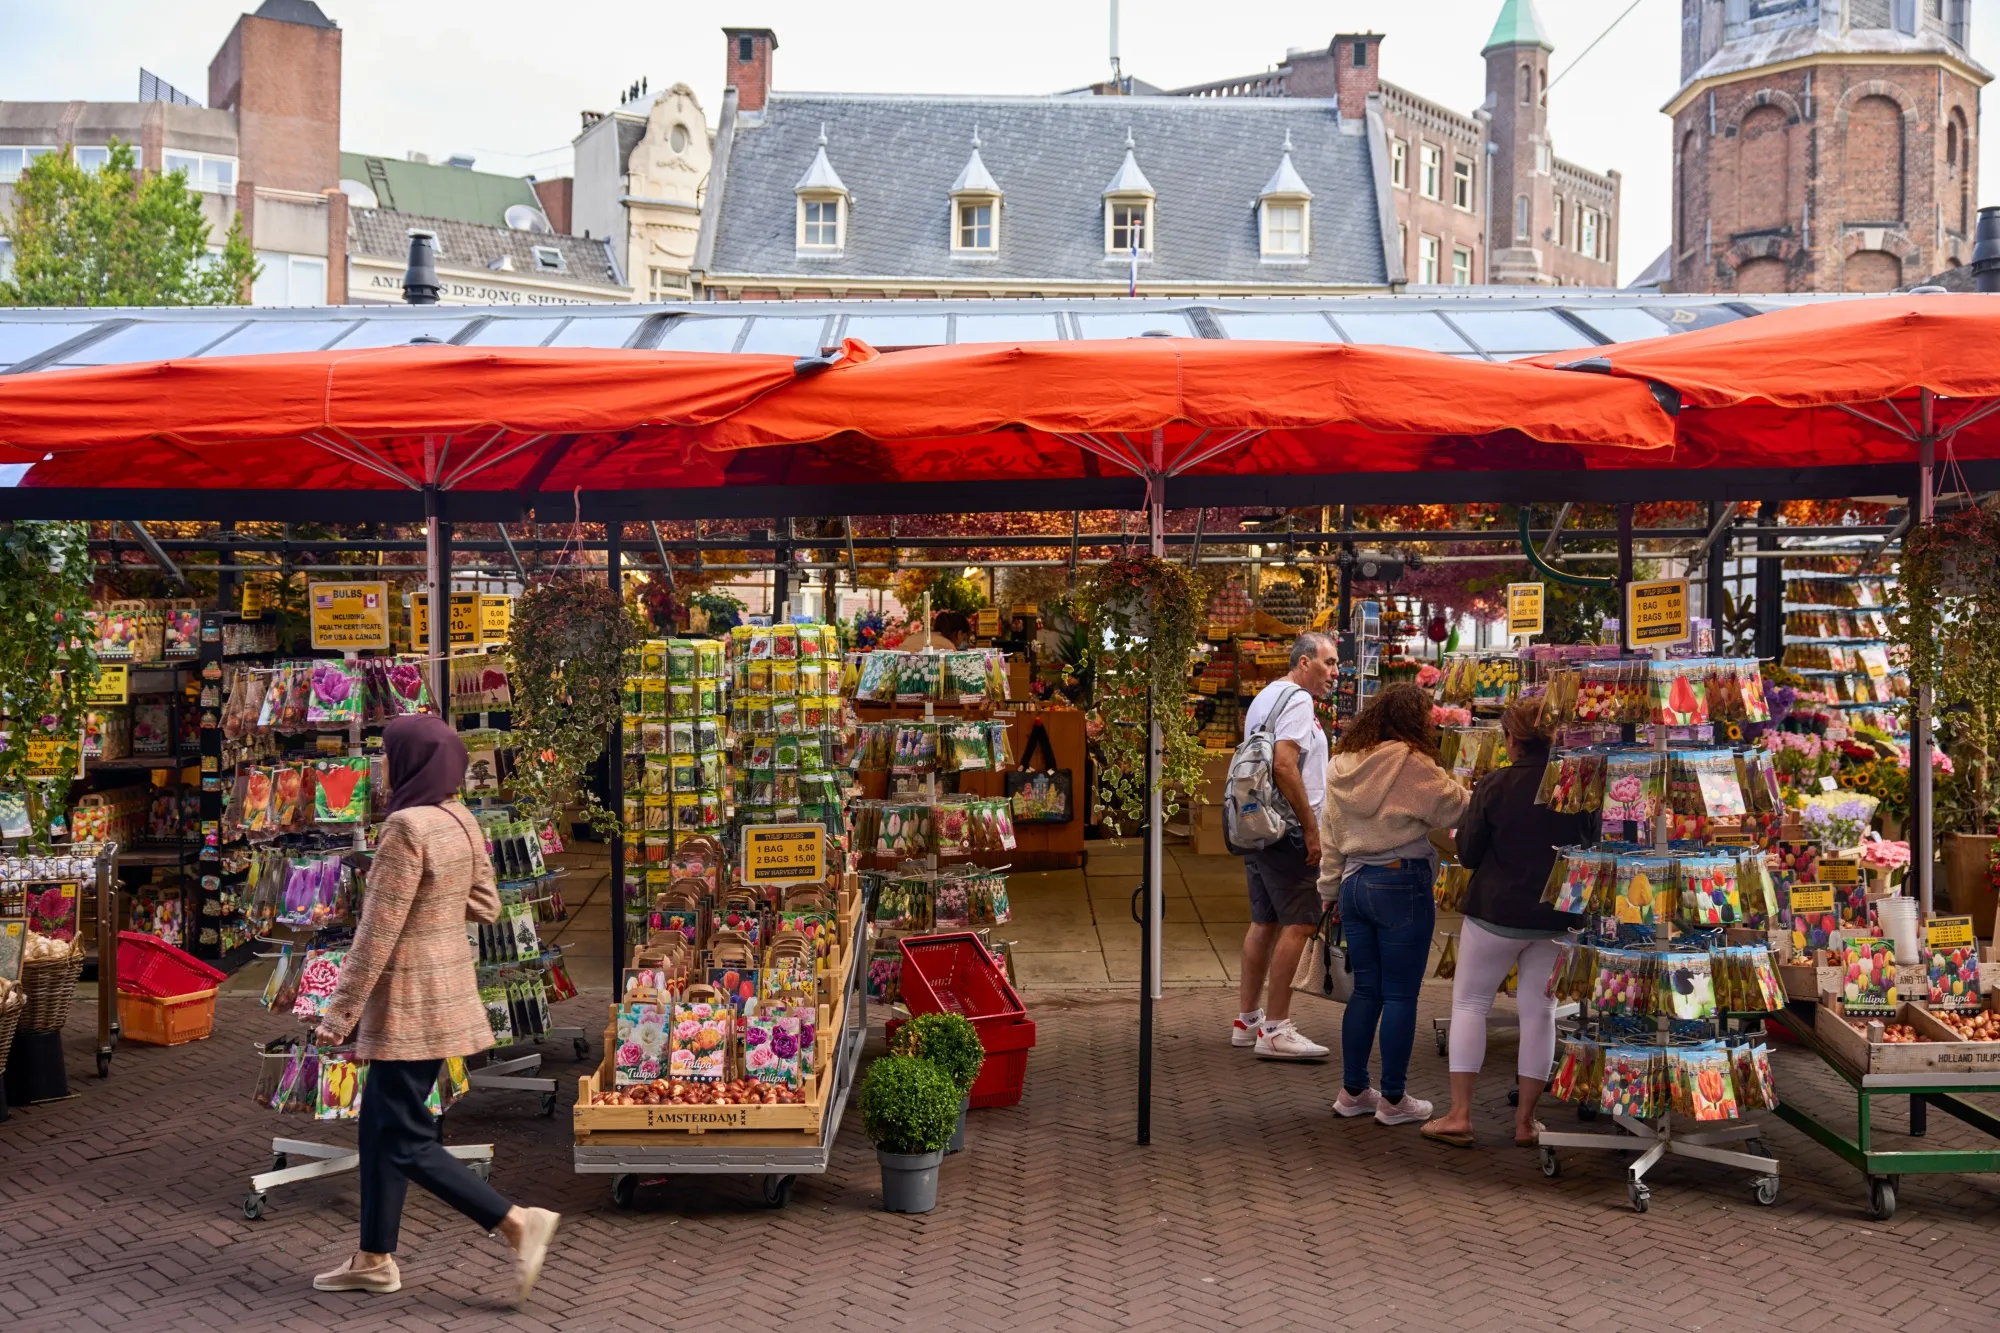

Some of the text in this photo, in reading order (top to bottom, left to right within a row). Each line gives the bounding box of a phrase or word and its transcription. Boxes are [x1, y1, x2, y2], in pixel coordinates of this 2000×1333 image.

[453, 285, 475, 298] DE
[333, 590, 362, 598] BULBS
[1642, 601, 1658, 610] BAG
[1667, 599, 1680, 608] 6,00
[1637, 611, 1681, 623] 2 BAGS 10,00
[420, 622, 427, 631] 3
[764, 845, 784, 853] BAG
[798, 844, 815, 852] 8,50
[794, 854, 816, 863] 15,00
[1857, 993, 1887, 1005] Tulipa
[1940, 993, 1971, 1005] Tulipa
[1938, 1053, 1973, 1063] HOLLAND
[683, 1059, 713, 1071] Tulipa
[628, 1068, 658, 1081] Tulipa
[757, 1072, 786, 1084] Tulipa
[656, 1113, 737, 1122] AMSTERDAM
